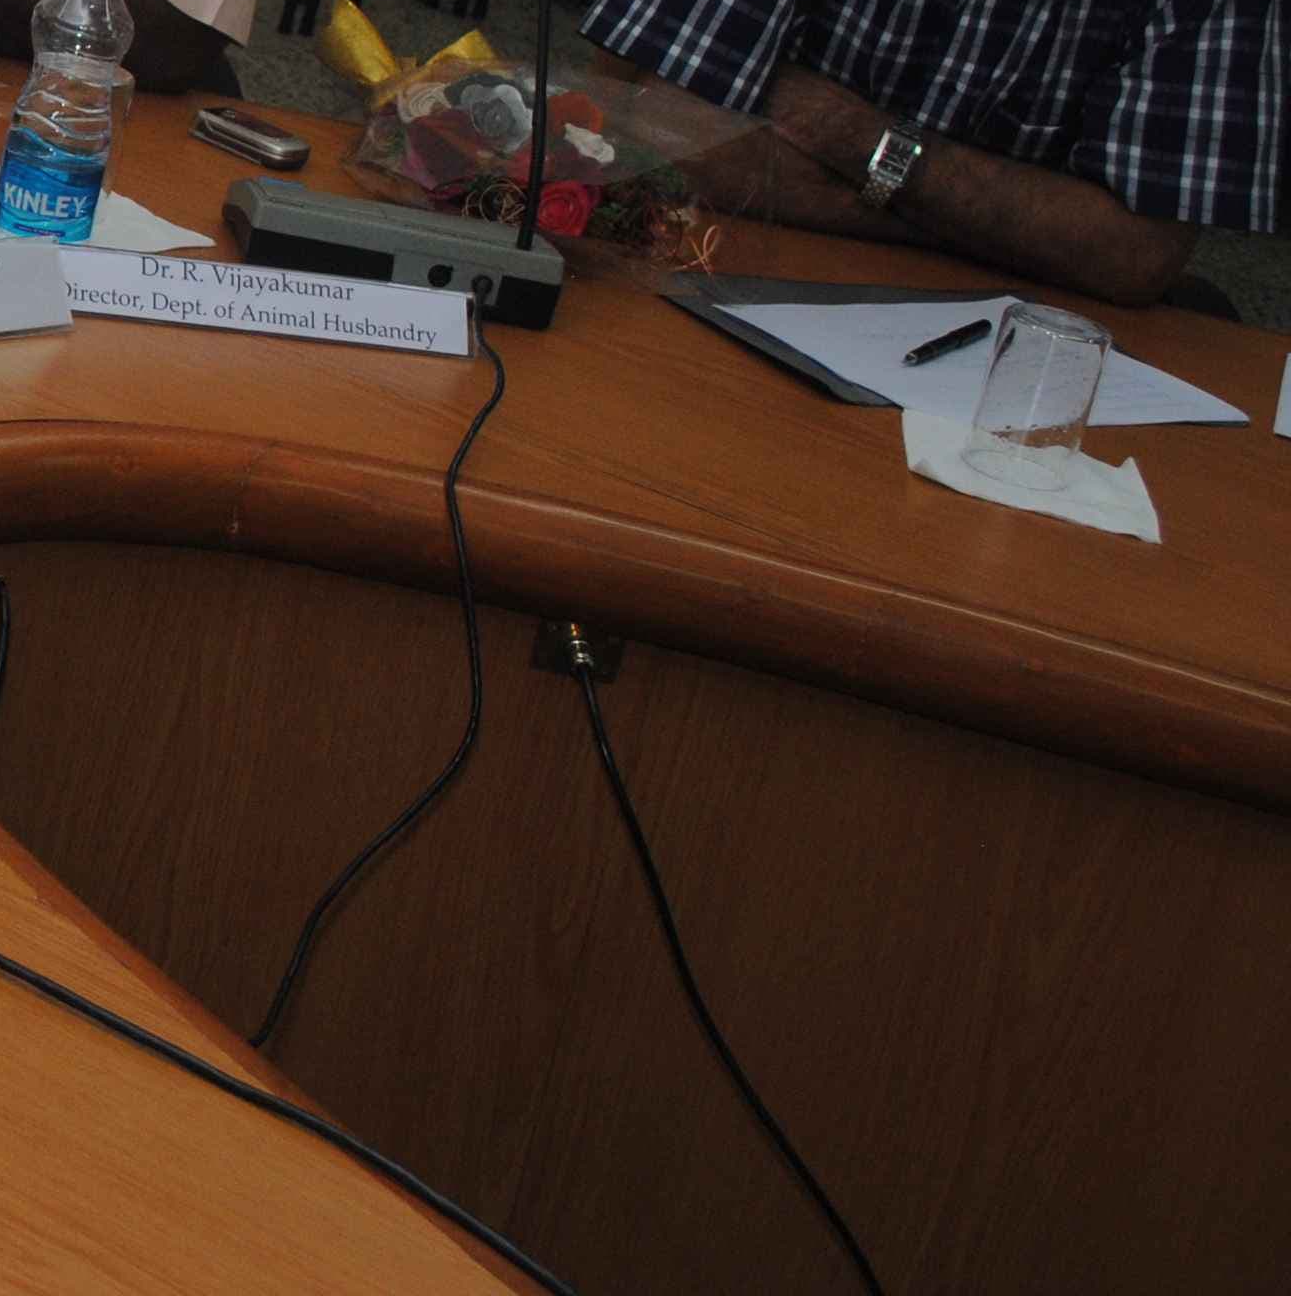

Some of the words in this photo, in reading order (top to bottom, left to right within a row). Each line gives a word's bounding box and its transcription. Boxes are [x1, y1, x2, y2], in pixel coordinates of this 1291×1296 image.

[4, 182, 87, 218] KINLEY
[140, 256, 174, 280] Dr.
[182, 260, 203, 284] R.
[211, 262, 355, 302] Vijayakumar
[151, 291, 207, 321] Dept.
[214, 302, 237, 319] of
[240, 304, 316, 330] Animal
[322, 313, 438, 350] Husbandry
